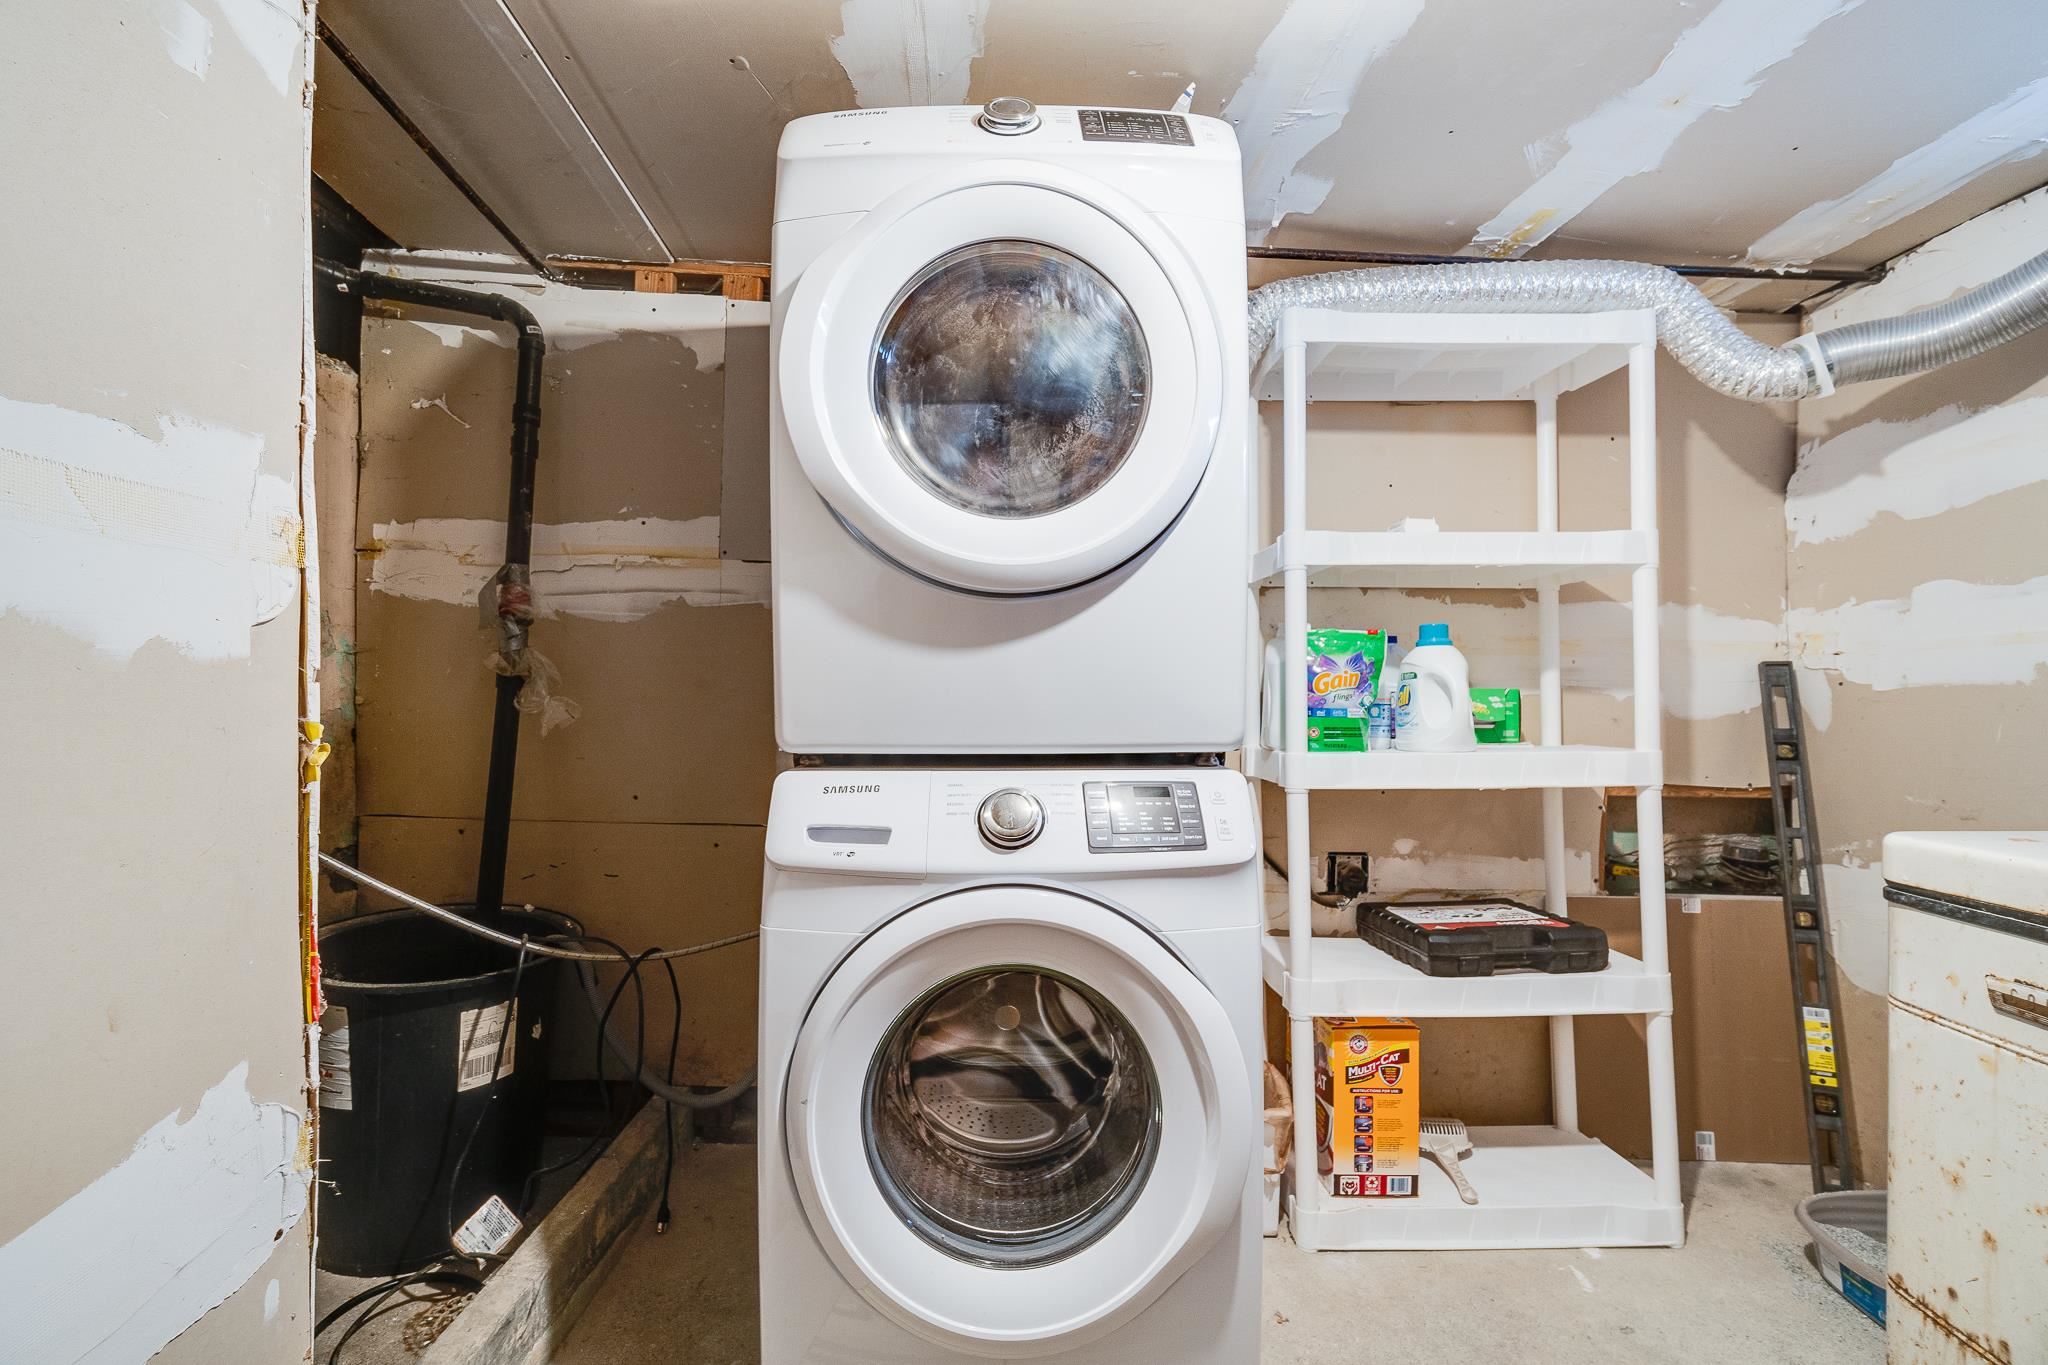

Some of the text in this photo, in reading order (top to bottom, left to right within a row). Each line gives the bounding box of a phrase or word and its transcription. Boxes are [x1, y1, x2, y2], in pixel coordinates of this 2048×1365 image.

[1313, 669, 1360, 694] Gain
[1331, 693, 1352, 703] flings
[823, 784, 880, 794] SAMSUNG
[1348, 1053, 1401, 1077] MULTI-CAT
